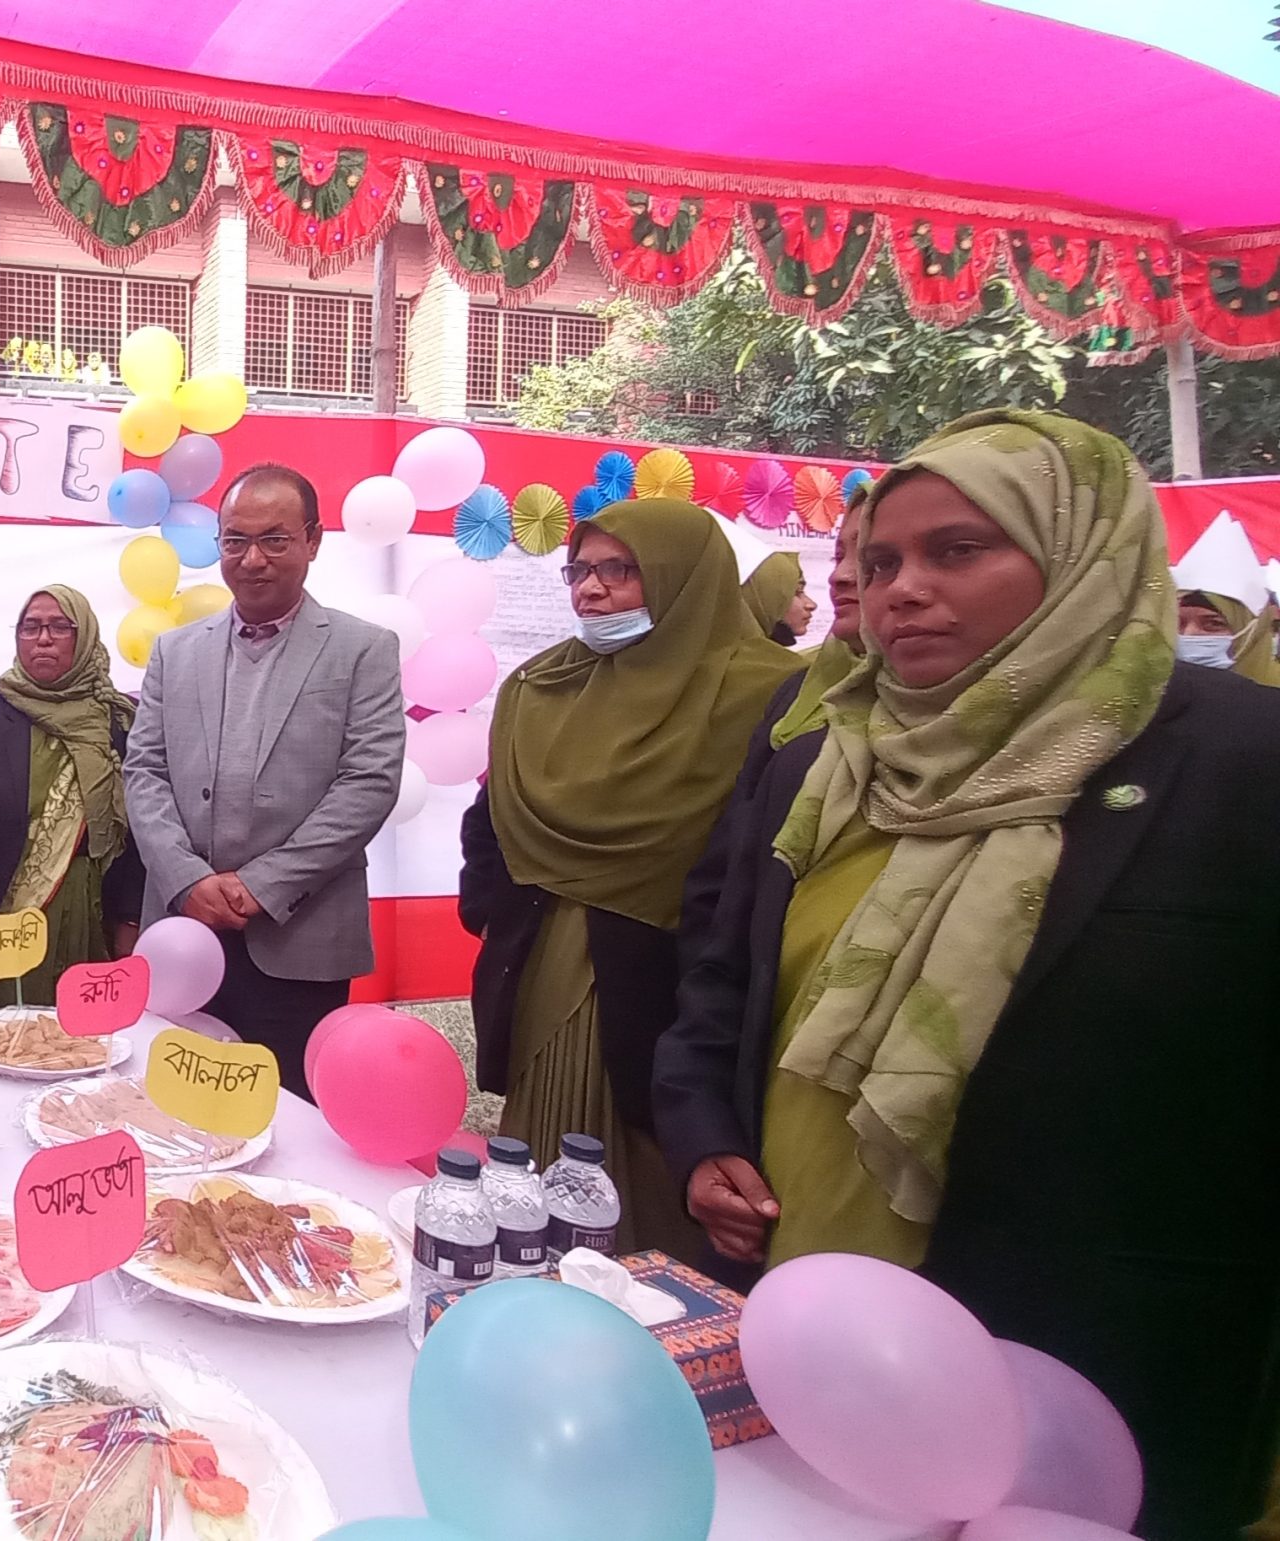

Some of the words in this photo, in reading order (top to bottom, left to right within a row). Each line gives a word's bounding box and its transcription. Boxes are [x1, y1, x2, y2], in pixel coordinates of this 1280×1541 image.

[80, 968, 130, 1004] রুটি
[28, 1170, 97, 1215] আলু
[91, 1146, 140, 1198] ভর্তা
